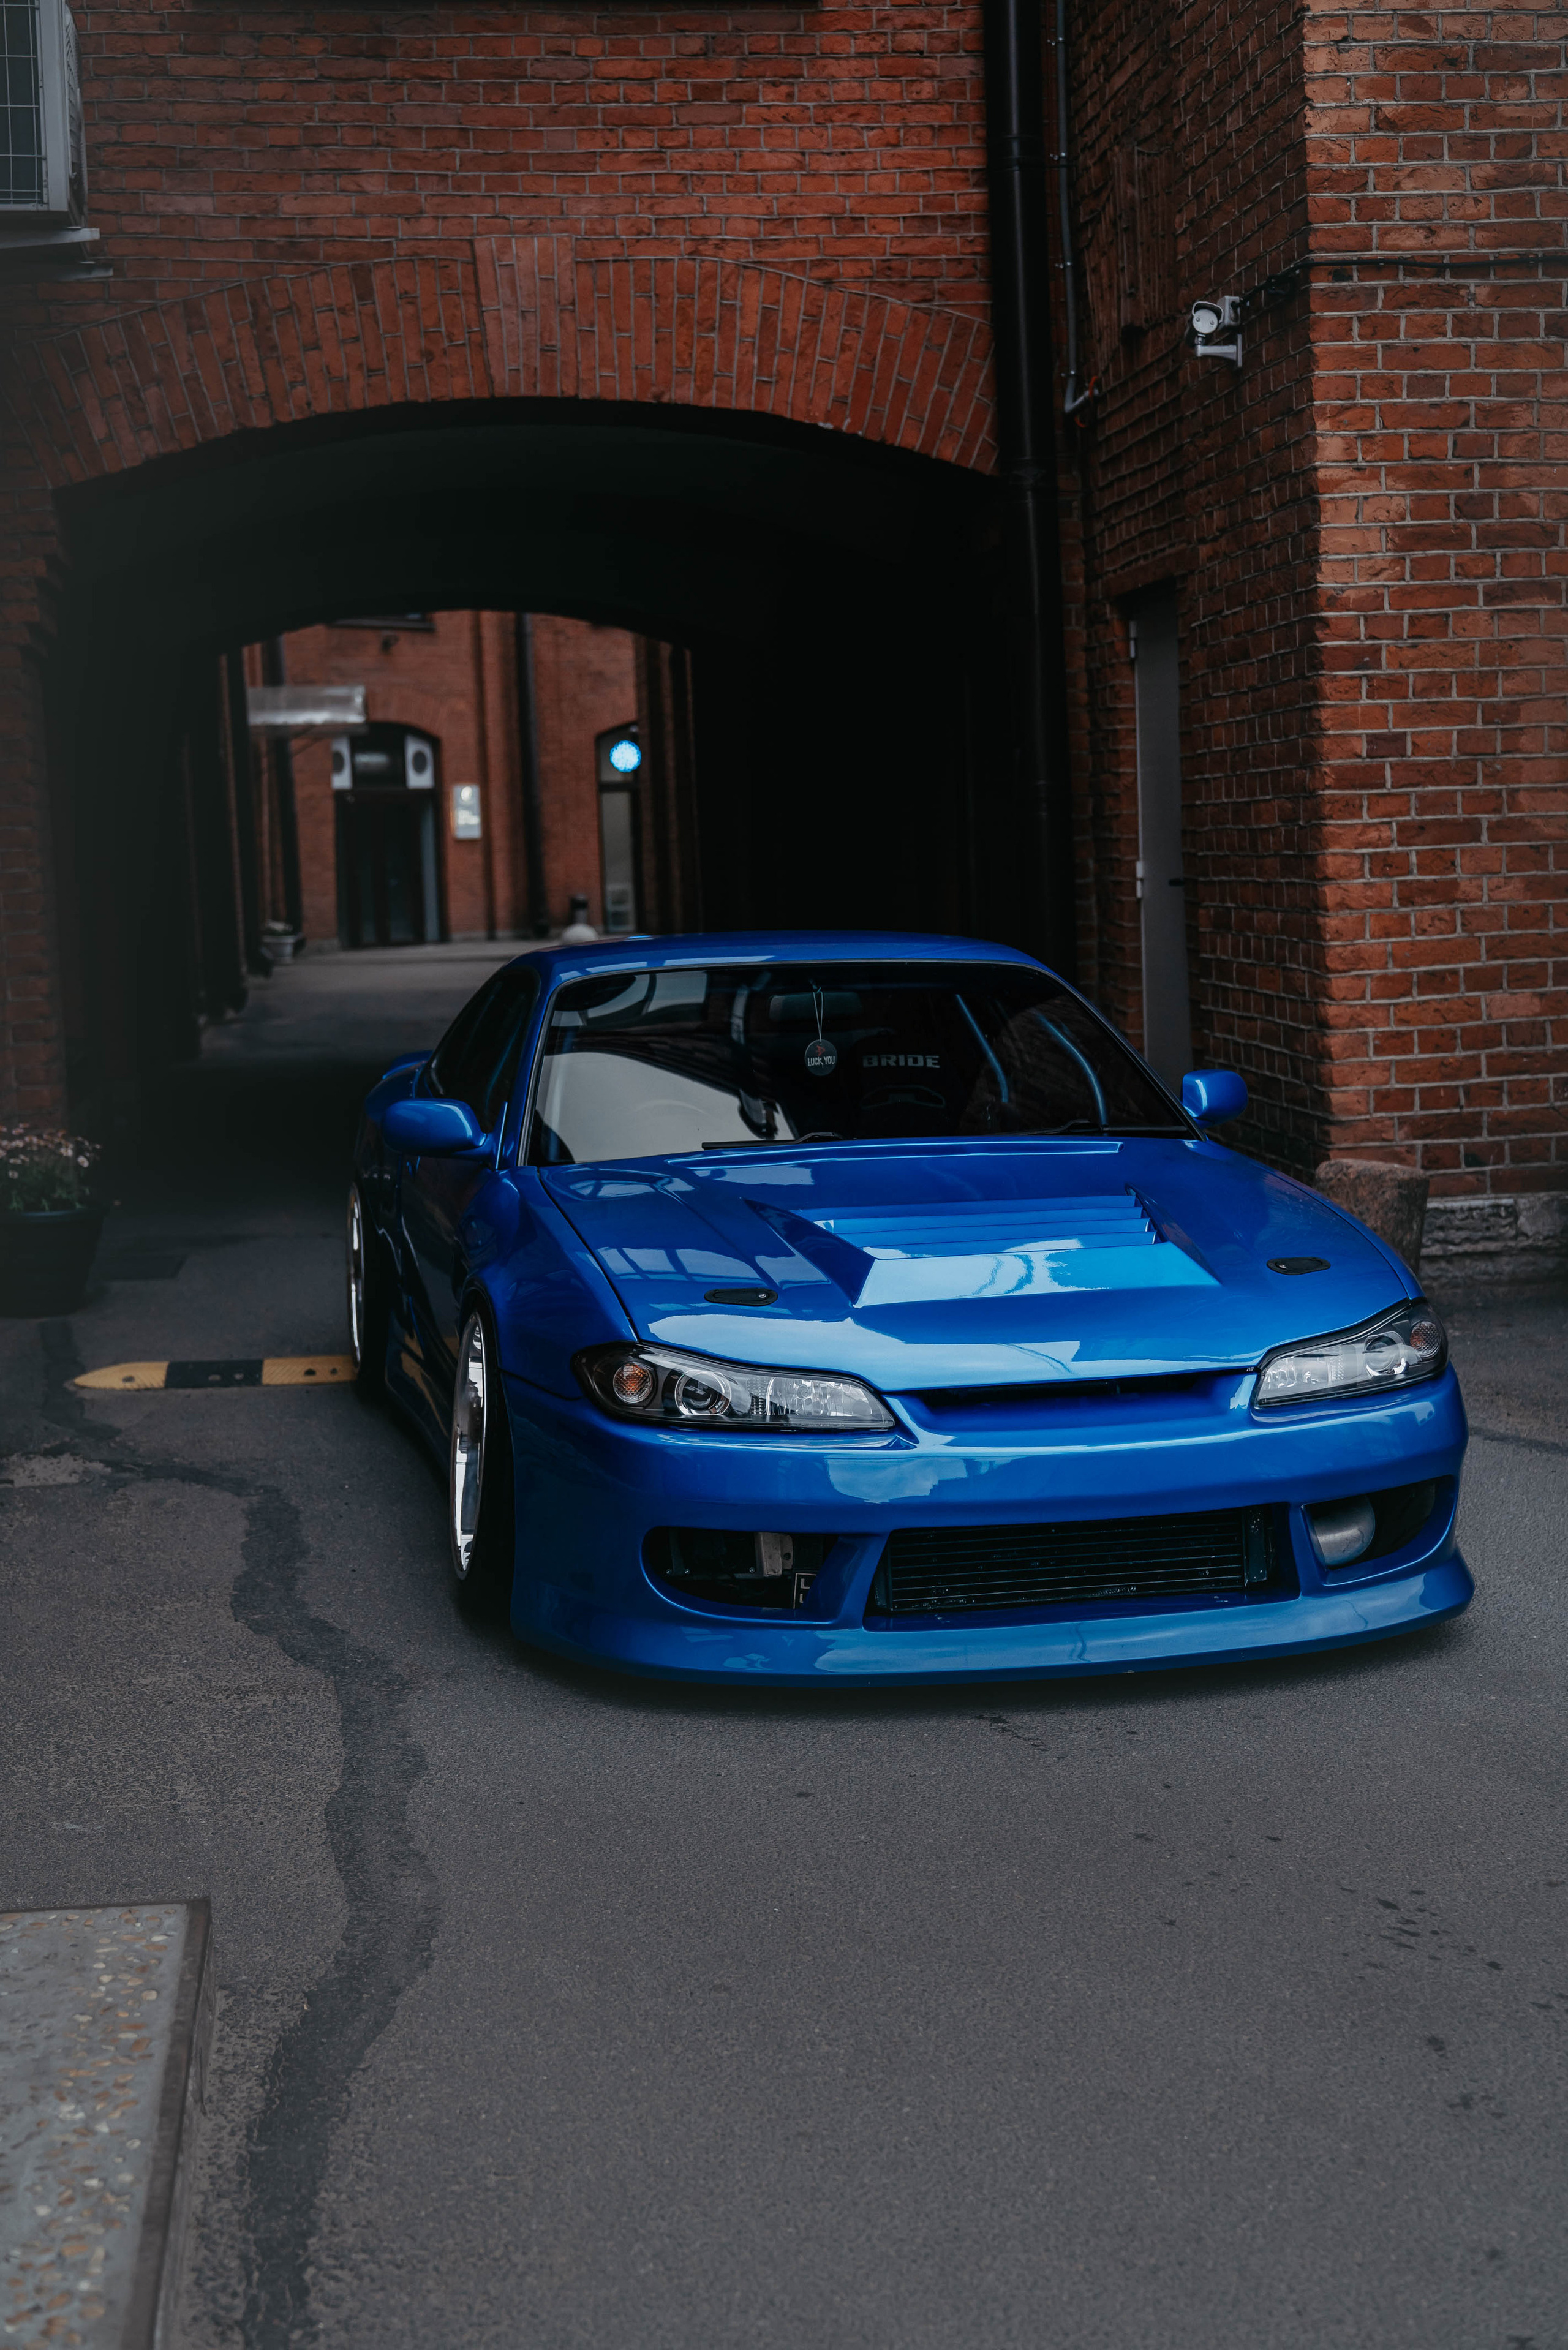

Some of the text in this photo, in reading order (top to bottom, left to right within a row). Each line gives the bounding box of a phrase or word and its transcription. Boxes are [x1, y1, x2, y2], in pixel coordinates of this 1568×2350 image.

[807, 1055, 835, 1068] LUCK YOU
[862, 1053, 941, 1068] BRIDE
